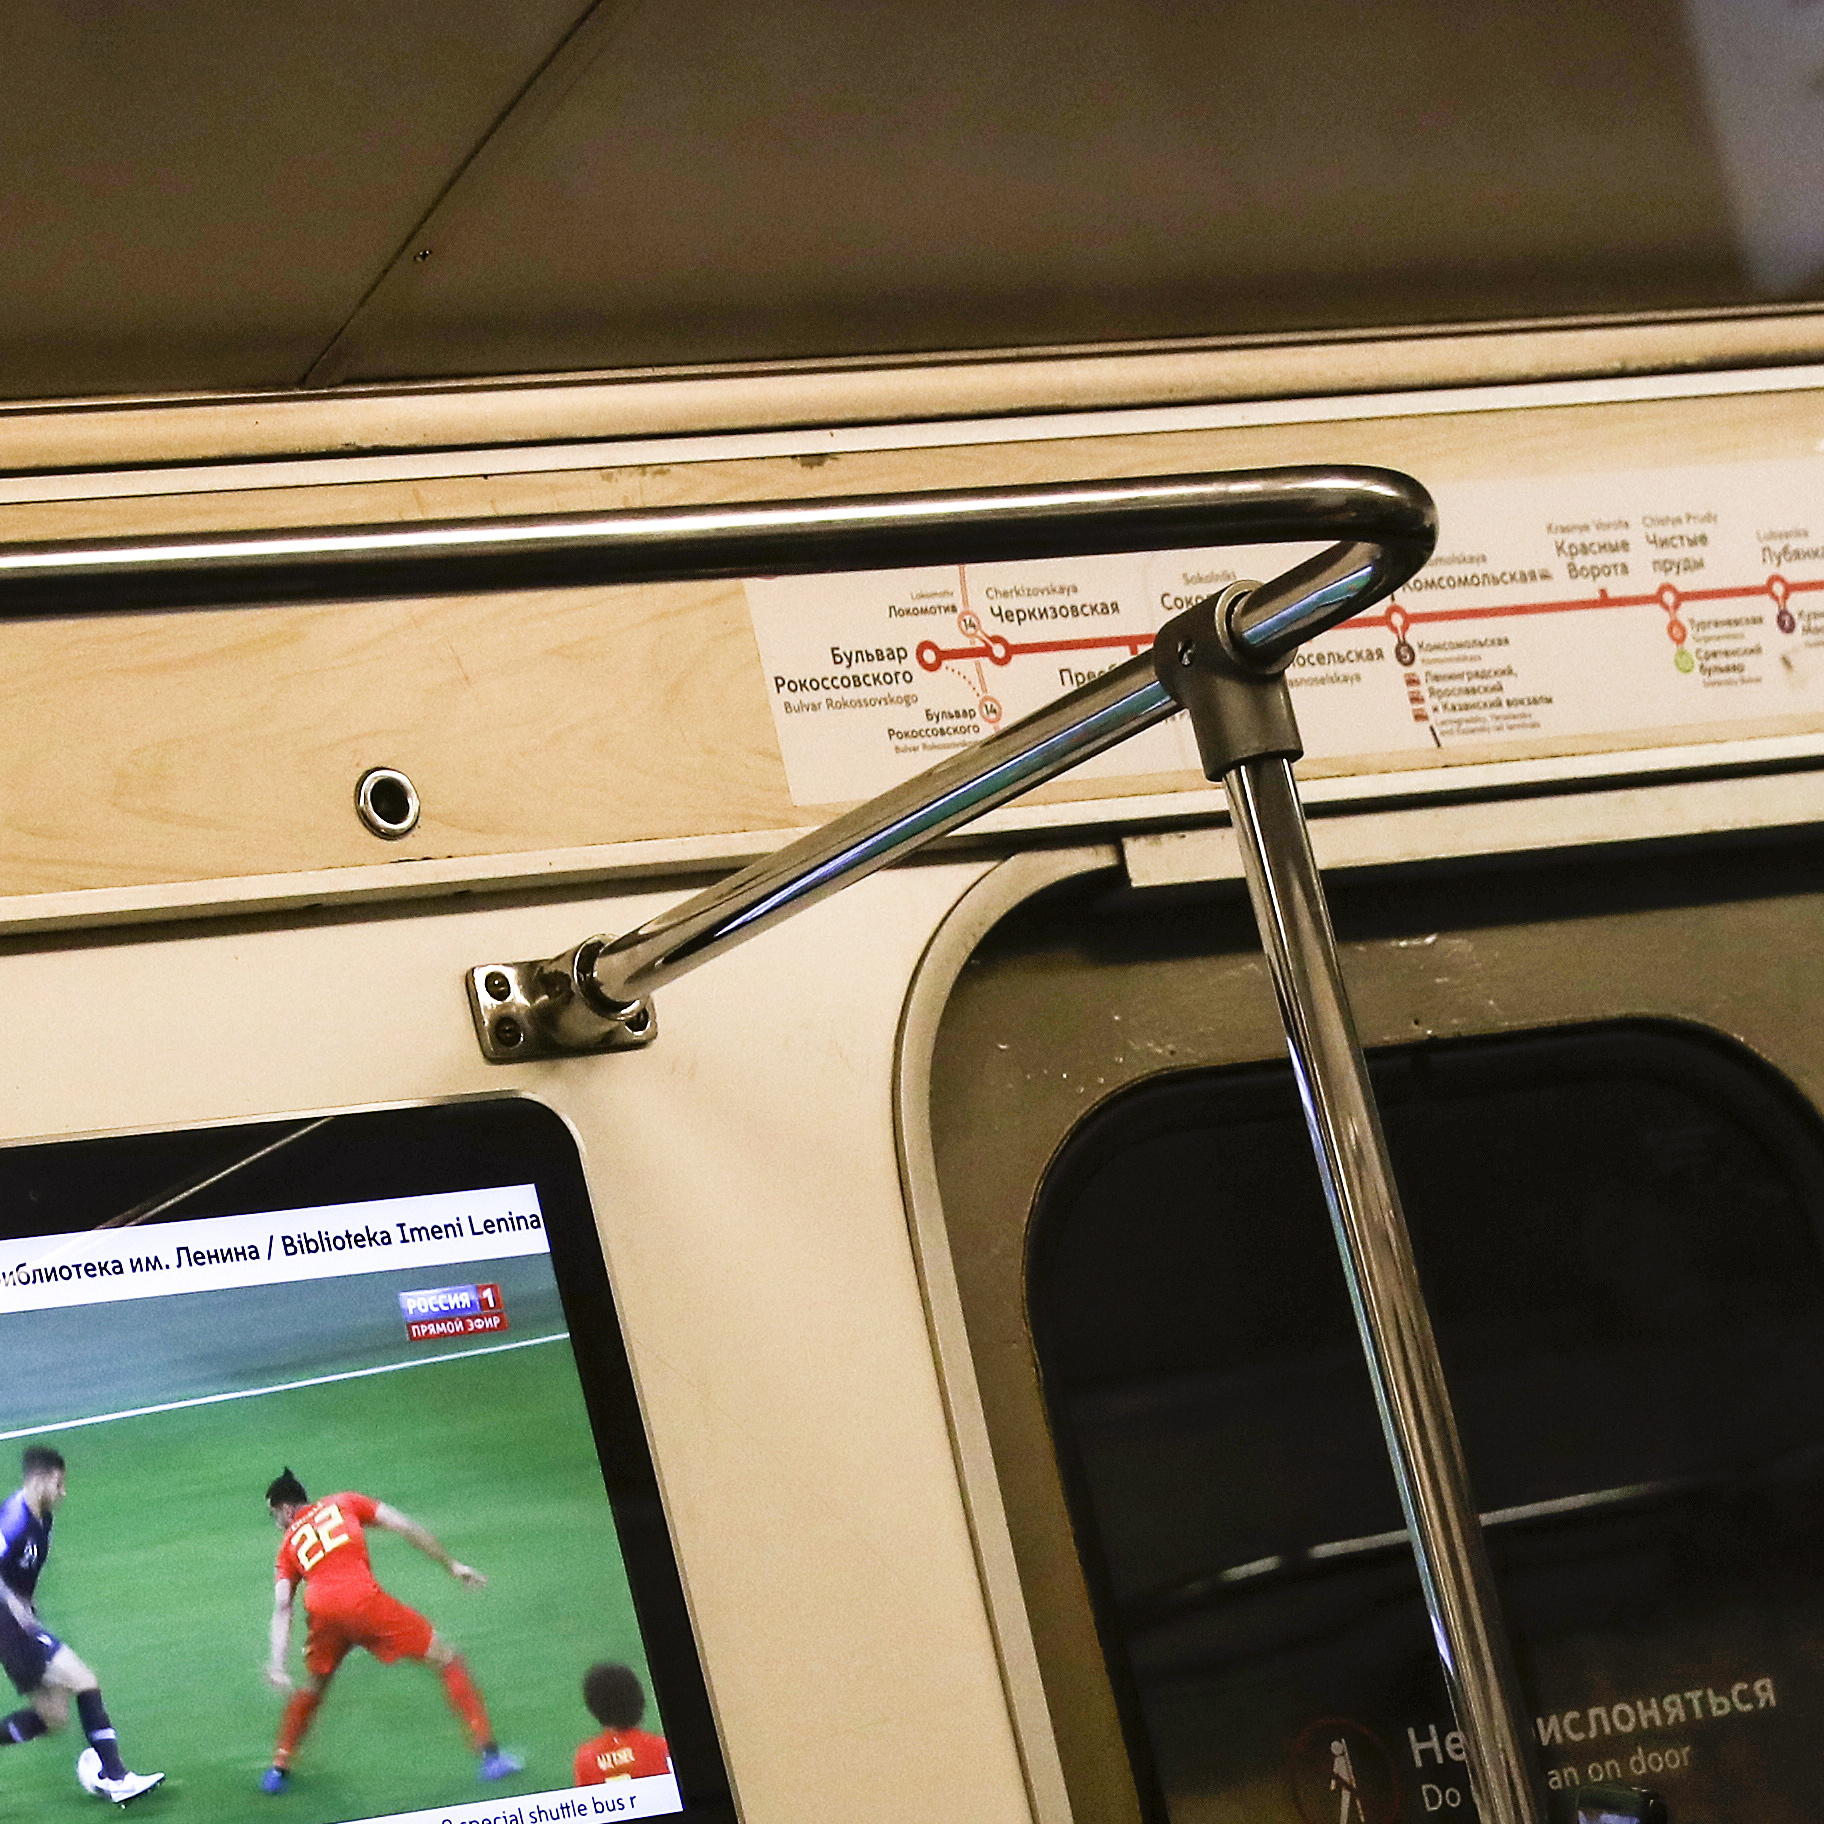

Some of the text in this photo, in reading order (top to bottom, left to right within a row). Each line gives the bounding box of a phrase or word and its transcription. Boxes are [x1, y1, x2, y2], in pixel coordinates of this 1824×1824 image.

[1555, 537, 1630, 558] Красные
[1645, 532, 1709, 550] Чистые
[1567, 561, 1629, 581] Ворота
[1652, 557, 1705, 576] пруды
[985, 584, 1078, 600] Cherkizovskaya
[888, 604, 957, 618] Локомотив
[990, 604, 1120, 625] Черкизовская
[831, 646, 908, 668] Бульвар
[1290, 646, 1385, 667] осельская
[774, 669, 913, 693] Рокоссовского
[784, 693, 918, 714] Bulvar Rokossovskogo
[925, 708, 976, 724] Бульвар
[888, 723, 980, 741] Рокоссовского
[130, 1253, 171, 1274] им.
[176, 1242, 261, 1269] Ленина
[281, 1226, 394, 1257] Biblioteka
[395, 1217, 464, 1244] Imeni
[469, 1211, 542, 1236] Lenina
[405, 1286, 496, 1315] РОССИЯ 1
[410, 1315, 501, 1339] ПРЯМОЙ ЭФИР
[290, 1503, 350, 1572] 22
[1406, 1677, 1778, 1769] Не ислоняться
[1421, 1782, 1462, 1812] Do
[1546, 1765, 1578, 1791] an
[1587, 1761, 1622, 1783] on
[1628, 1743, 1693, 1777] door
[528, 1798, 588, 1824] shuttle
[590, 1796, 626, 1815] bus
[628, 1792, 638, 1809] r
